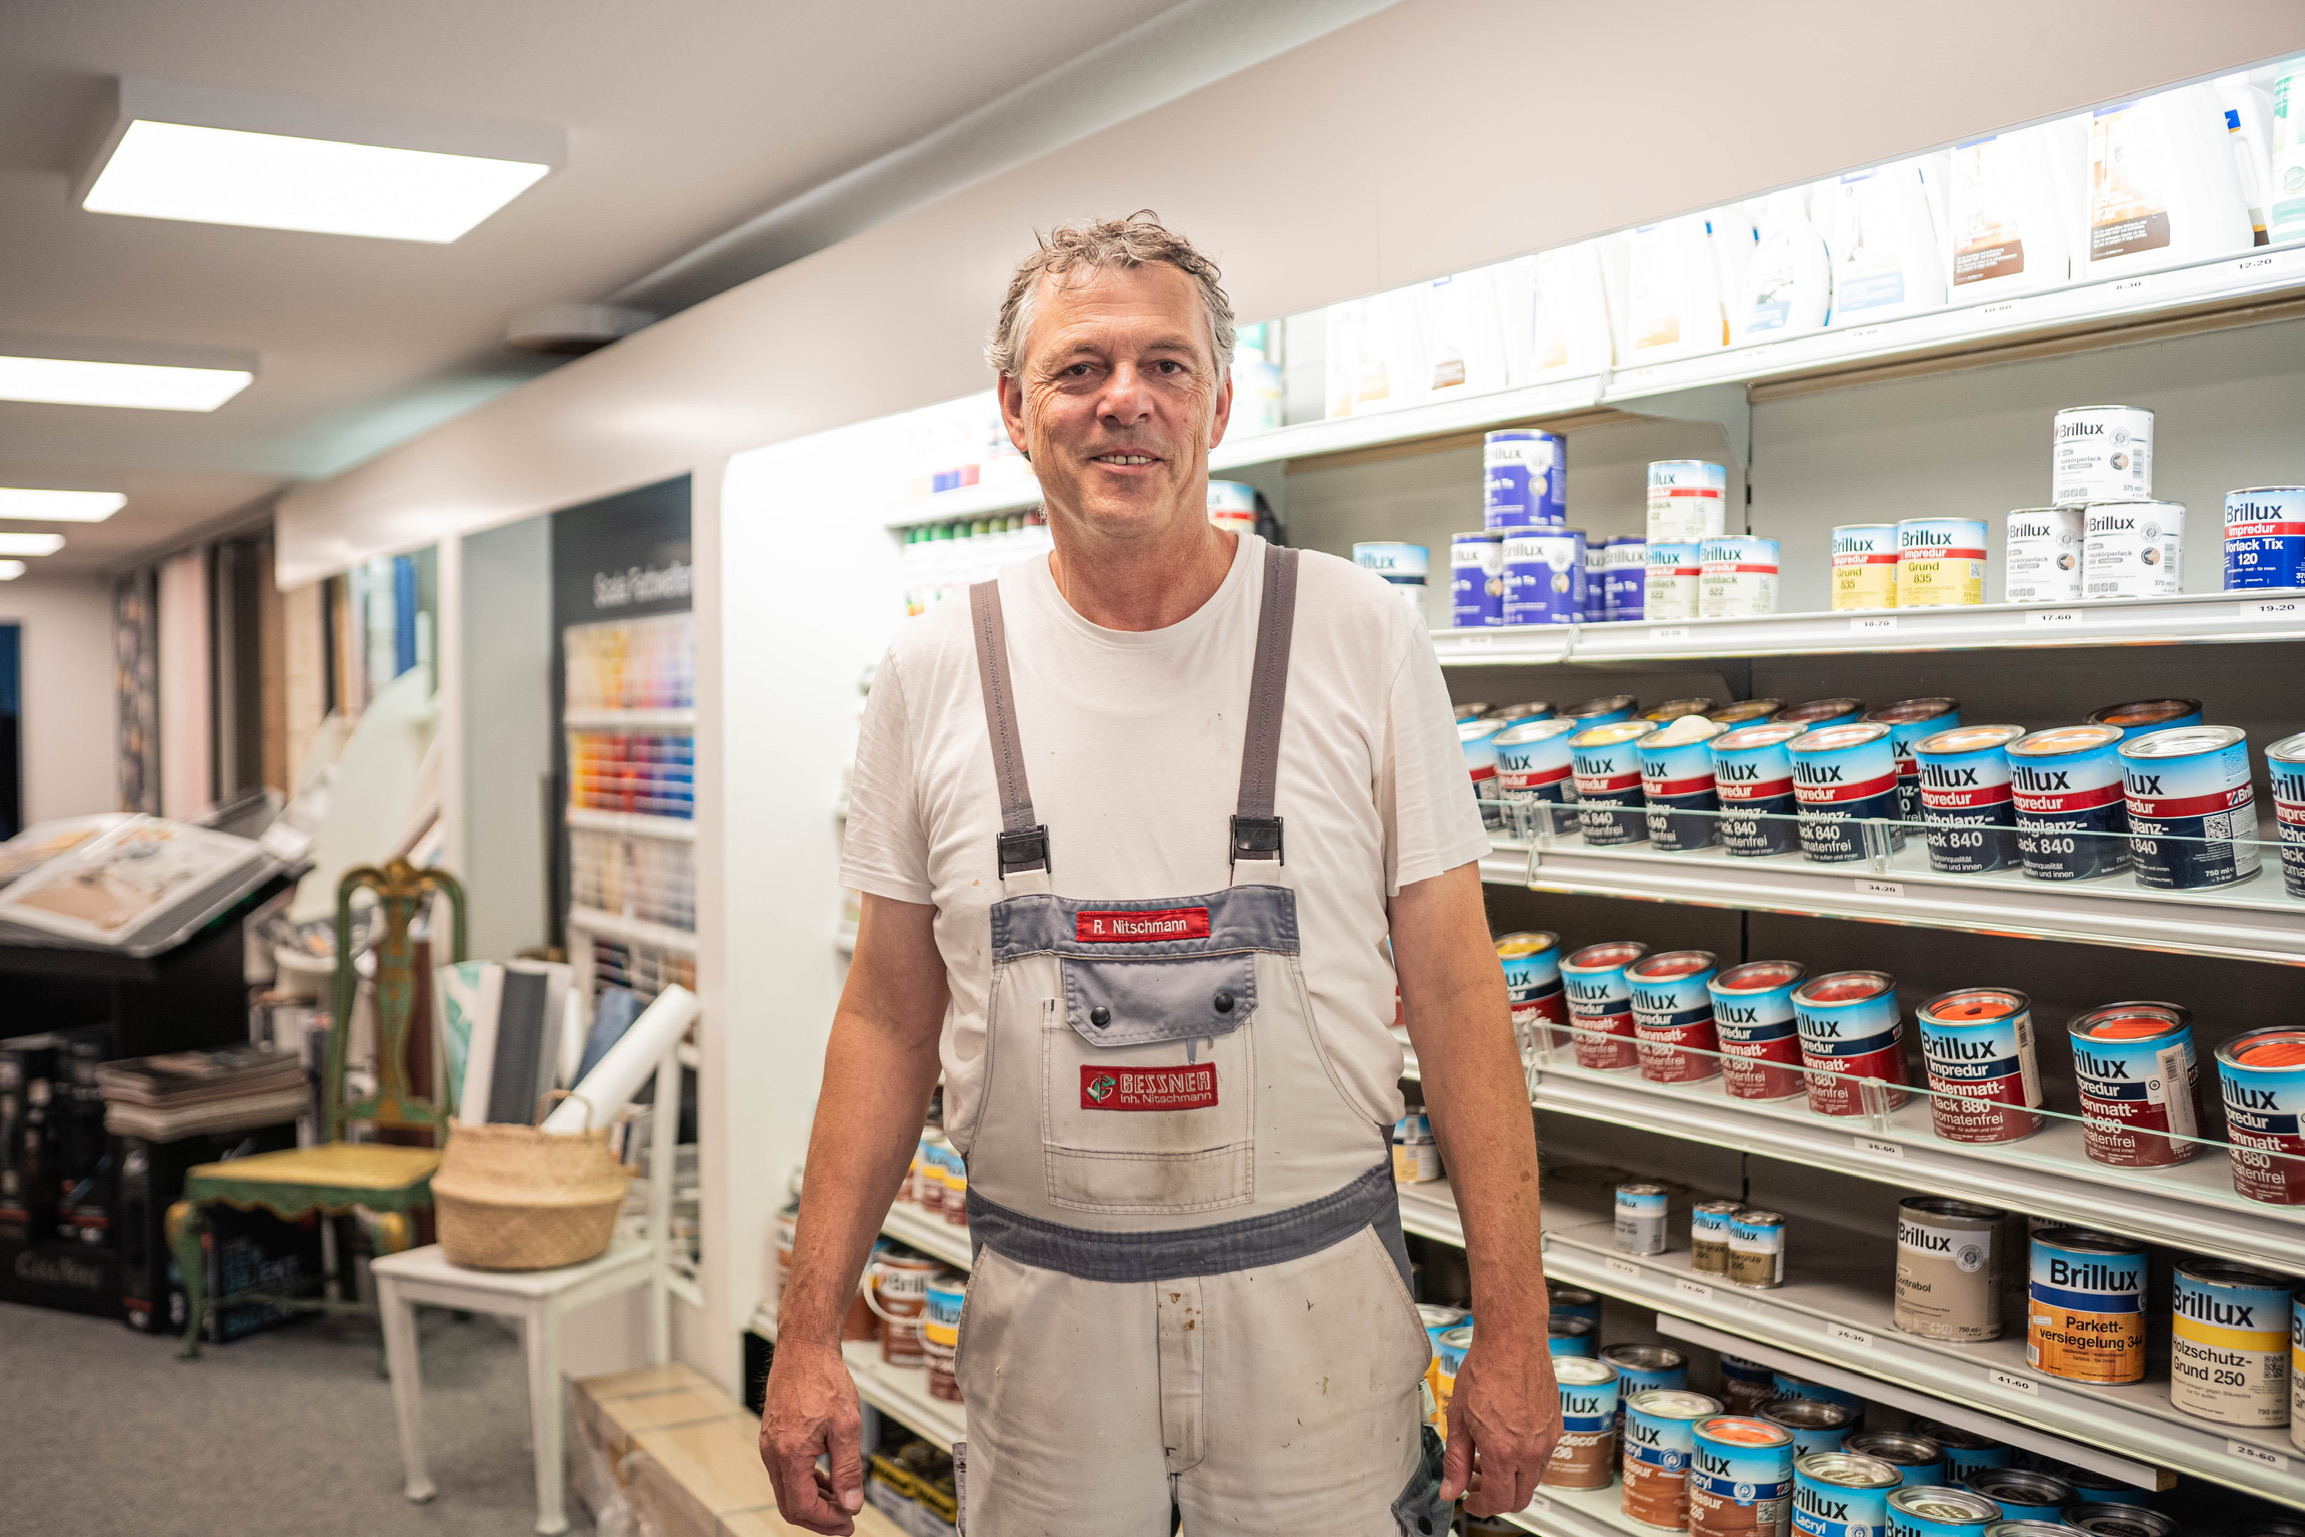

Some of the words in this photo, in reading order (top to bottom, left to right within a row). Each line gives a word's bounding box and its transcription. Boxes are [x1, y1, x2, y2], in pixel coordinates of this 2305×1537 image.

[2239, 258, 2273, 270] 12.20
[2059, 422, 2105, 438] Brillux
[2226, 502, 2283, 523] Brillux
[2010, 523, 2050, 539] Brillux
[2089, 516, 2136, 532] Brillux
[2229, 523, 2276, 537] Impredur
[1832, 537, 1874, 554] Brillux
[1902, 530, 1952, 547] Brillux
[2225, 539, 2260, 553] Vorlack
[2262, 538, 2284, 550] Tix
[1701, 547, 1742, 561] Brillux
[1904, 548, 1947, 559] Impredur
[2238, 553, 2258, 565] 120
[1837, 567, 1862, 577] Grund
[1908, 561, 1940, 572] Grund
[1840, 579, 1855, 589] 835
[1913, 574, 1932, 583] 835
[1709, 588, 1724, 596] 822
[2259, 604, 2295, 612] 19.20
[1794, 762, 1843, 783] rillux
[1921, 764, 1979, 787] rillux
[2012, 766, 2071, 791] rillux
[2123, 766, 2164, 795] llux
[1718, 785, 1752, 798] predur
[1795, 787, 1836, 800] mpredur
[2271, 772, 2305, 802] Brill
[1923, 792, 1972, 806] mpredur
[2014, 796, 2063, 810] mpredur
[2127, 799, 2155, 814] redur
[1592, 812, 1613, 825] 840
[2276, 803, 2305, 823] Impre
[1734, 821, 1757, 835] 840
[1800, 826, 1814, 840] ack
[1815, 825, 1840, 840] 840
[1927, 833, 1947, 848] ack
[1950, 832, 1983, 848] 840
[2018, 838, 2038, 853] ack
[2040, 838, 2075, 854] 840
[2135, 838, 2157, 855] 840
[2205, 869, 2219, 877] 750
[2220, 867, 2229, 875] ml
[1869, 884, 1896, 893] 34.20
[1093, 919, 1105, 934] R.
[1113, 919, 1187, 934] Nitschmann
[1633, 989, 1679, 1009] rillux
[1797, 1012, 1842, 1038] illux
[1922, 1031, 1997, 1060] Brillux
[1930, 1059, 1988, 1077] Impredur
[2073, 1048, 2130, 1079] rillux
[1120, 1071, 1210, 1094] GESSNER
[2077, 1075, 2119, 1097] predur
[1120, 1093, 1140, 1104] Inh.
[1142, 1091, 1212, 1104] Nitschmann
[2222, 1075, 2279, 1110] illux
[1934, 1094, 1959, 1112] lack
[1961, 1098, 1991, 1113] 880
[2080, 1093, 2138, 1117] denmatt-
[2096, 1116, 2122, 1134] 880
[2226, 1107, 2269, 1129] predur
[2083, 1127, 2135, 1147] matenfrei
[2243, 1150, 2270, 1169] 880
[1617, 1198, 1637, 1208] rillux
[1899, 1222, 1951, 1252] Brillux
[2050, 1258, 2139, 1291] Brillux
[2173, 1284, 2254, 1328] Brillux
[2066, 1316, 2124, 1333] Parkett-
[2040, 1328, 2125, 1351] versiegelung
[2127, 1335, 2143, 1348] 344
[2173, 1337, 2252, 1367] Holzschutz-
[2174, 1356, 2209, 1381] Grund
[2214, 1369, 2245, 1387] 250
[1997, 1376, 2029, 1389] 41.60
[1560, 1391, 1599, 1413] llux
[2237, 1445, 2276, 1463] 25.60
[1796, 1509, 1826, 1535] Lacryl
